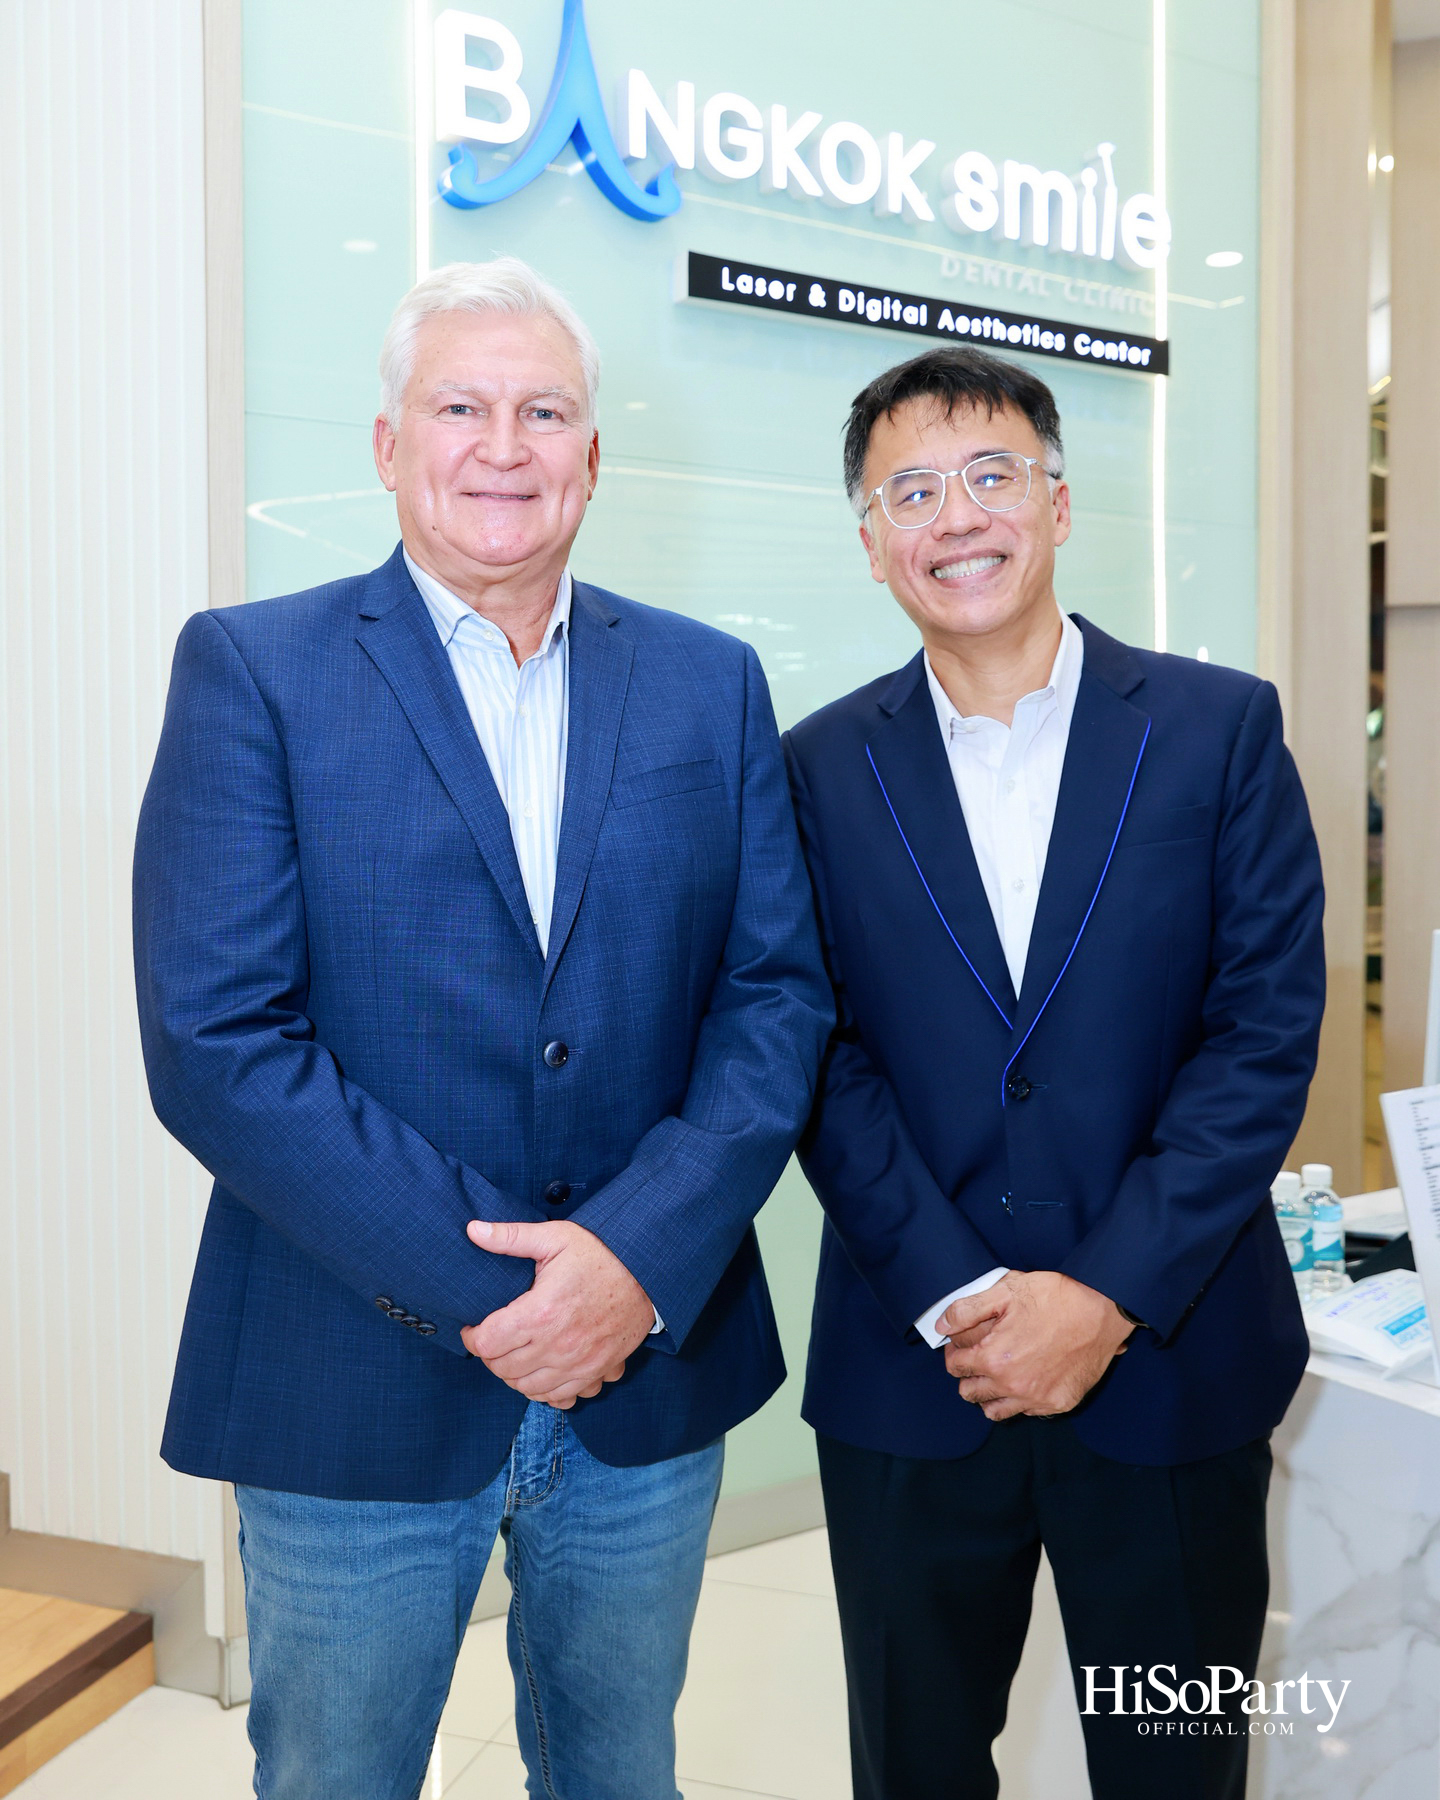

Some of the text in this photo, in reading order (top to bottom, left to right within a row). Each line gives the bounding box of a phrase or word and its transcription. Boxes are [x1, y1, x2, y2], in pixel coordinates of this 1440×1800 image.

[435, 0, 1172, 269] BANGKOK smile
[808, 283, 827, 308] &
[838, 287, 928, 327] Digital
[941, 253, 1156, 317] DENTAL CLINIC
